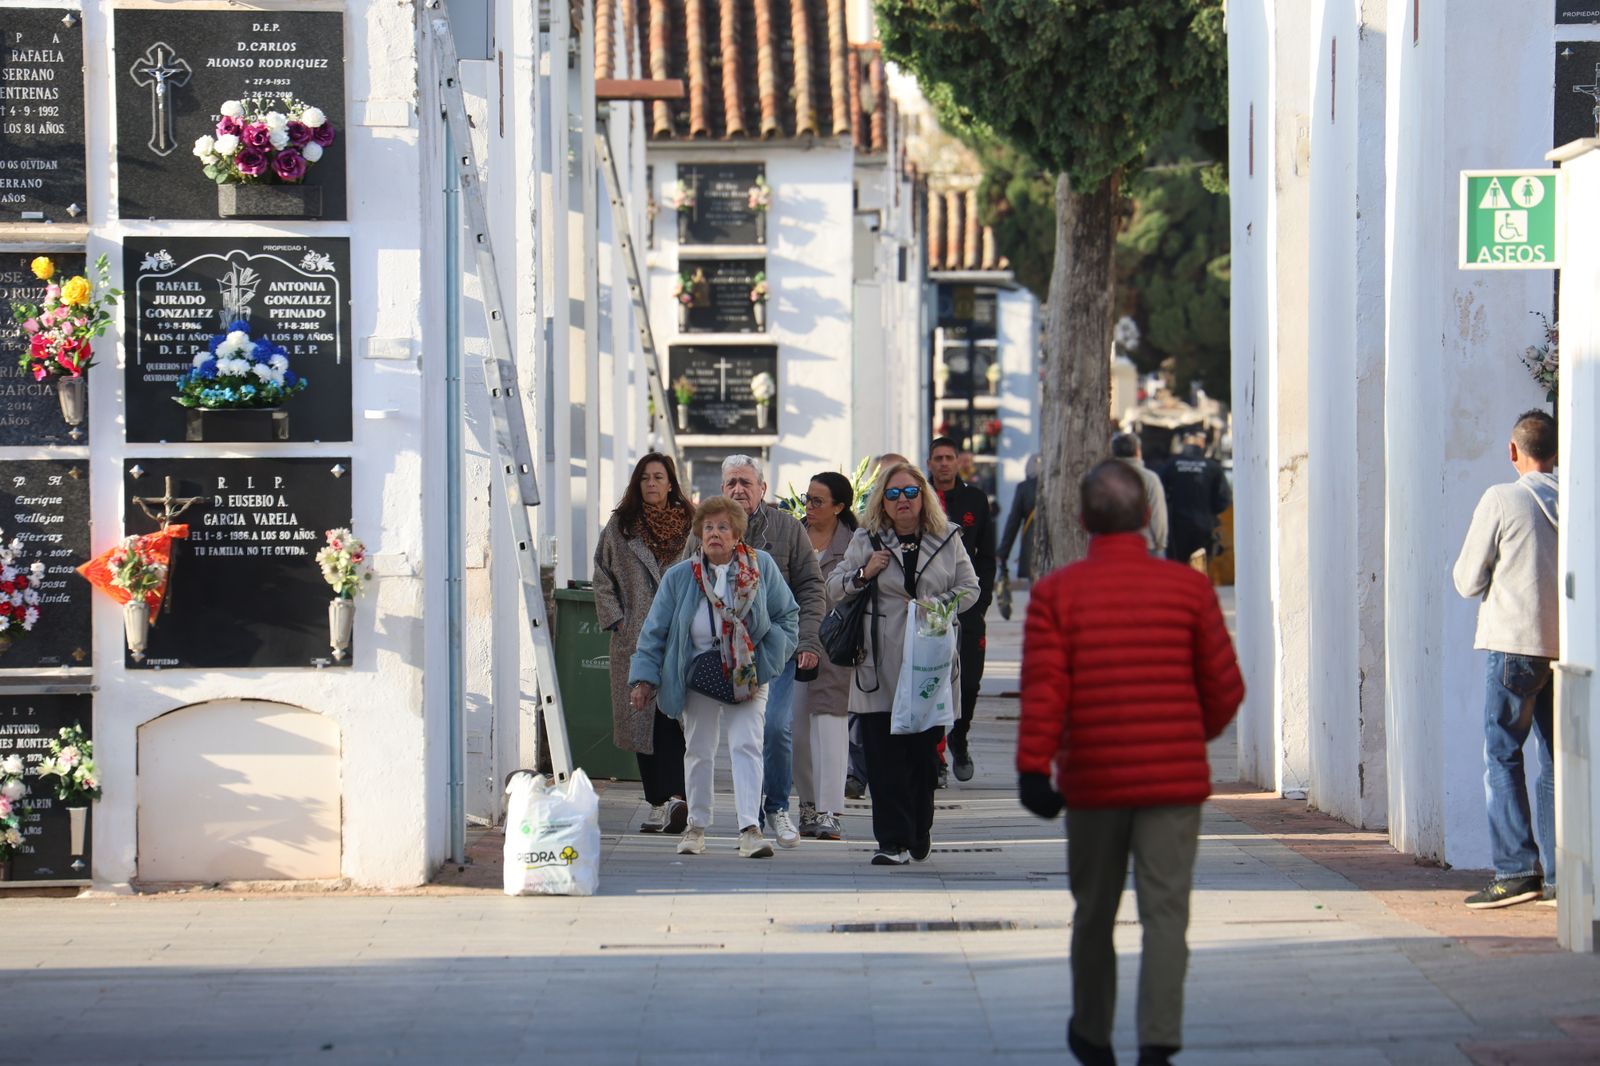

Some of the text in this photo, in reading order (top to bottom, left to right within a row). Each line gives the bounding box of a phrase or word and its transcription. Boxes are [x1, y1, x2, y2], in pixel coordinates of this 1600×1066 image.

[252, 24, 280, 32] D.E.P.
[16, 32, 60, 43] P A
[12, 50, 64, 62] RAFAELA
[206, 58, 328, 69] ALONSO RODRIGUEZ
[2, 68, 54, 80] SERRANO
[0, 87, 58, 99] ENTRENAS
[4, 124, 21, 134] LOS
[24, 124, 35, 134] 81
[21, 160, 58, 170] OLVIDAN
[2, 193, 26, 202] AÑOS
[1476, 244, 1546, 263] ASEOS
[156, 282, 202, 291] RAFAEL
[269, 282, 326, 291] ANTONIA
[12, 288, 45, 299] RUIZ
[152, 295, 206, 305] JURADO
[264, 296, 331, 305] GONZALEZ
[146, 308, 214, 318] GONZALEZ
[270, 309, 326, 318] PEINADO
[307, 332, 334, 341] AÑOS
[15, 495, 63, 506] Enrique
[228, 495, 274, 507] EUSEBIO
[204, 513, 298, 525] GARCIA VARELA
[16, 532, 63, 543] Herraz
[261, 532, 276, 540] LOS
[279, 532, 290, 540] 80
[194, 547, 205, 556] TU
[209, 547, 244, 556] FAMILIA
[247, 547, 258, 556] NO
[261, 547, 272, 556] TE
[0, 724, 40, 734] ANTONIO
